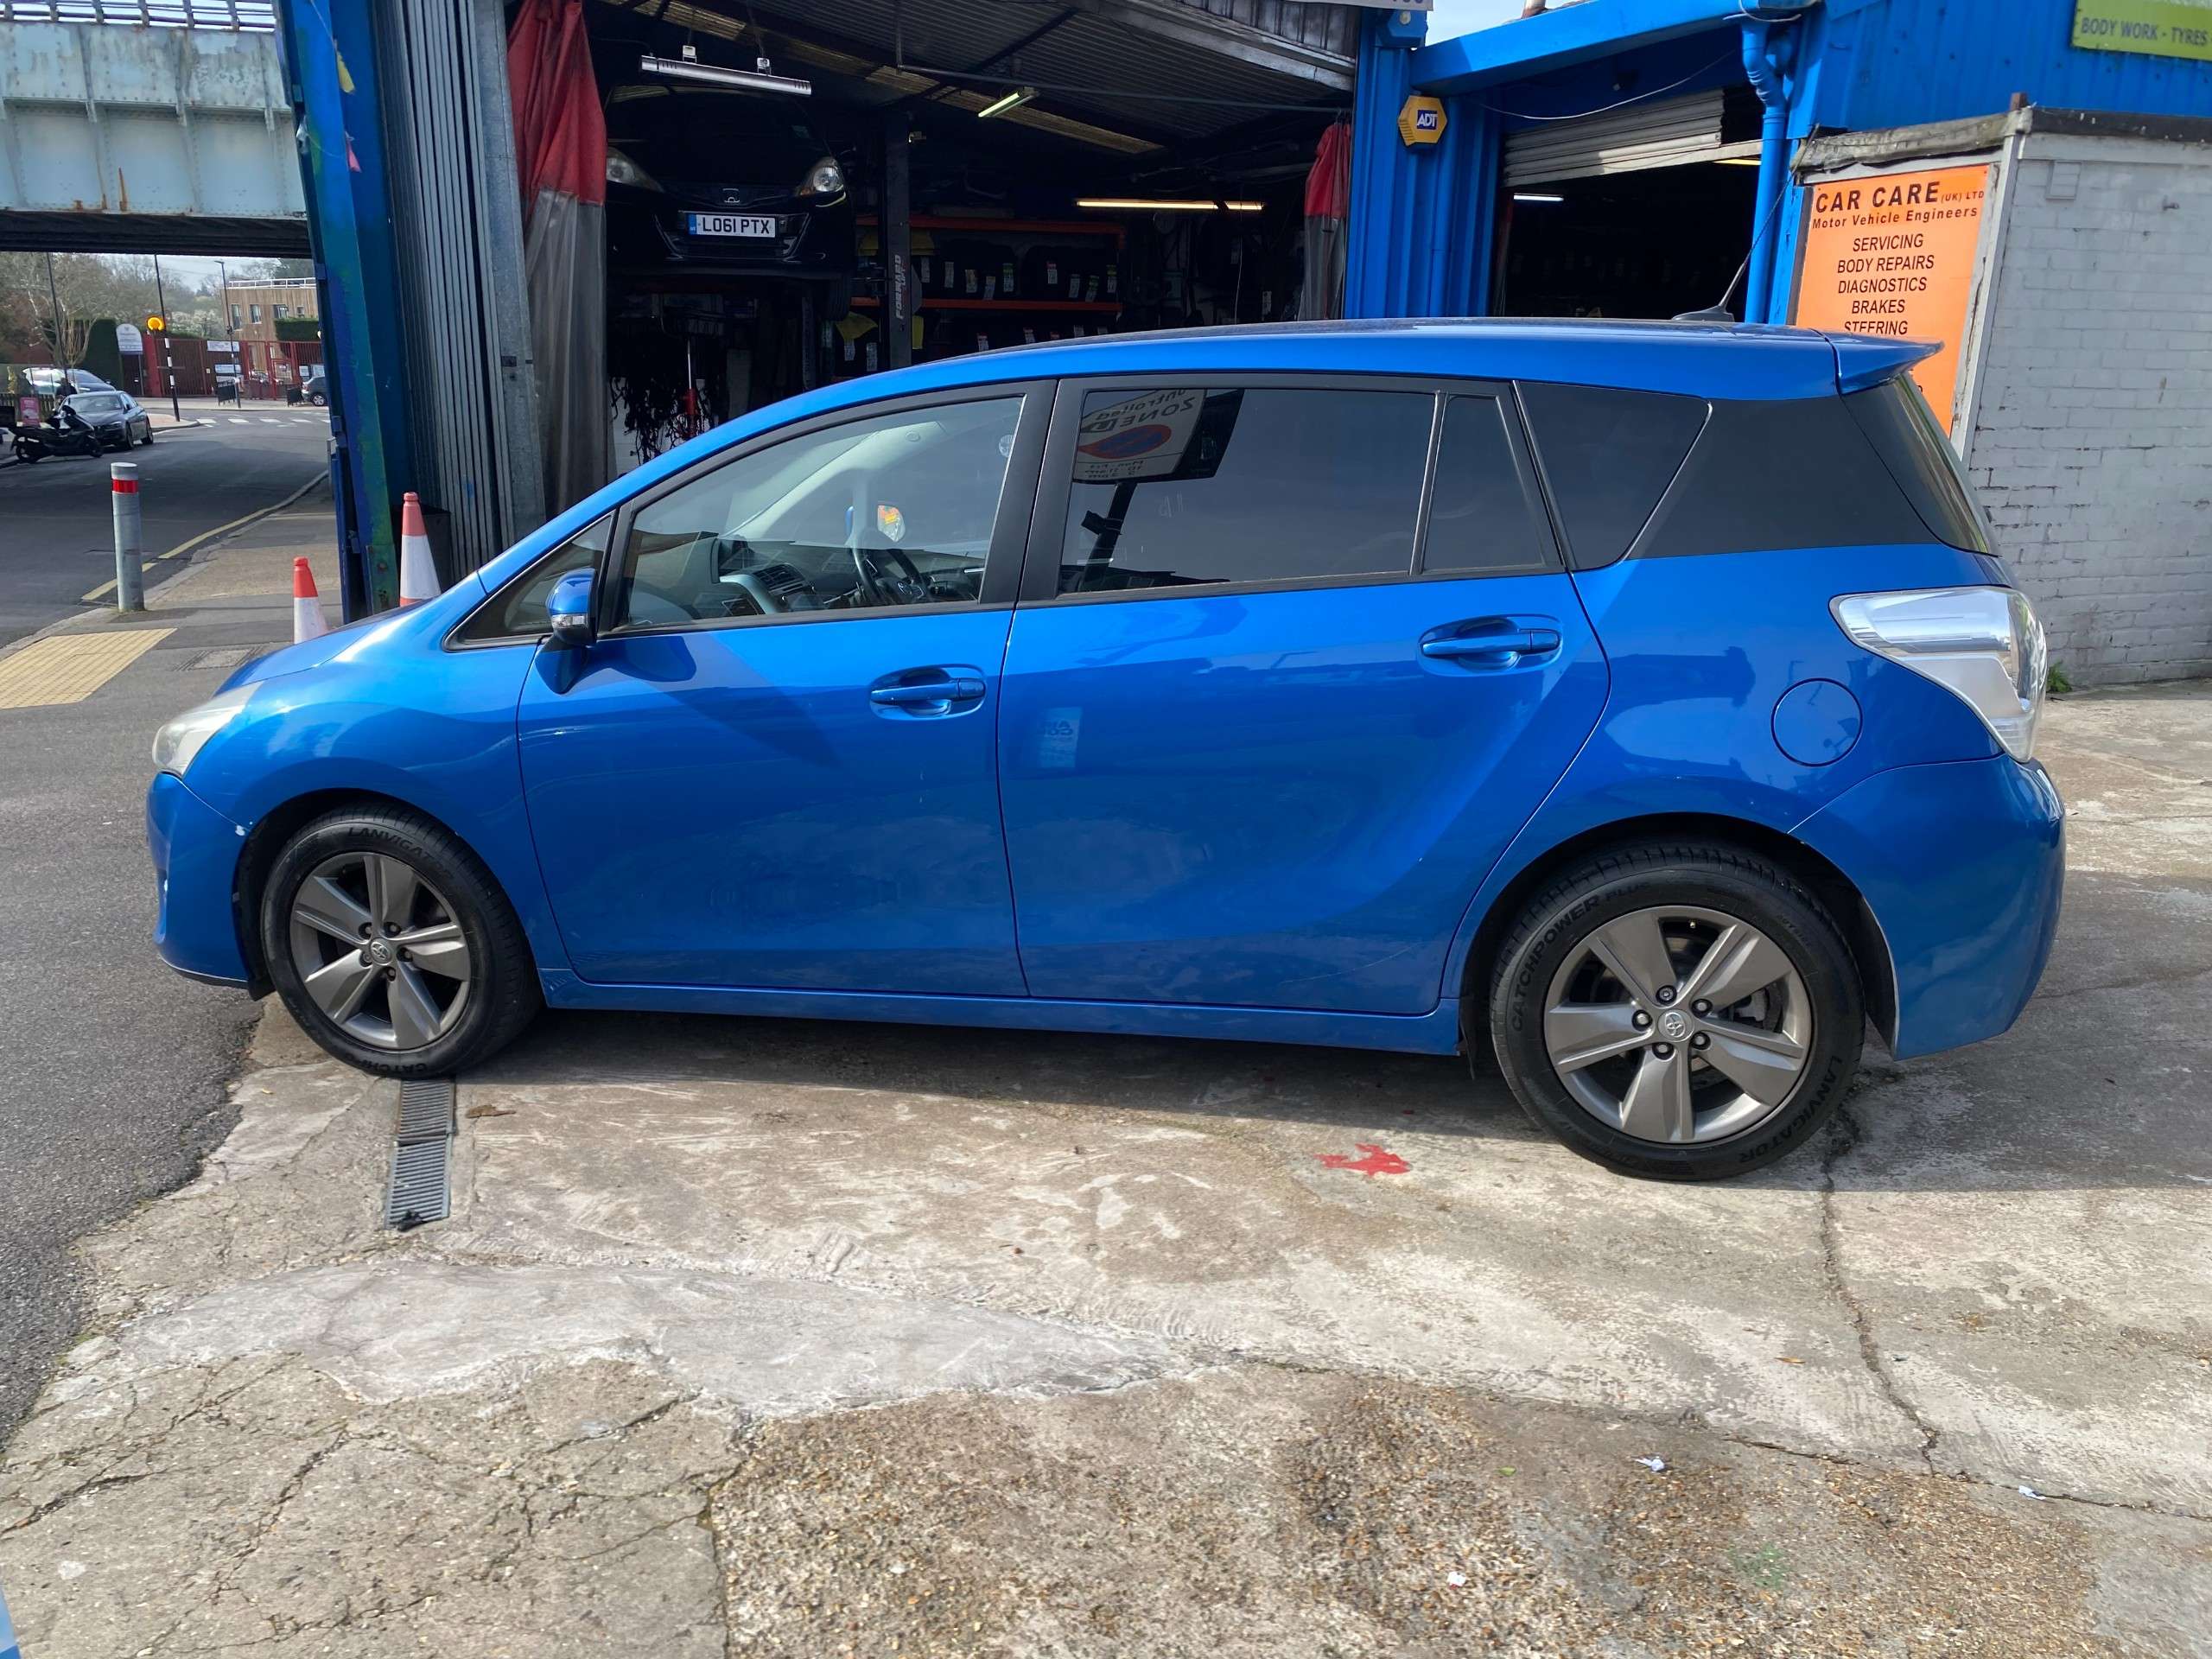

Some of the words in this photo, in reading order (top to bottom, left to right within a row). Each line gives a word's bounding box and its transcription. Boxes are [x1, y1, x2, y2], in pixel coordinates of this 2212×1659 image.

[2081, 17, 2117, 35] BODY
[2120, 20, 2158, 40] WORK
[2171, 27, 2209, 46] TYRES
[1417, 112, 1438, 127] ADT
[1815, 189, 1861, 213] CAR
[1872, 181, 1940, 207] CARE
[1941, 193, 1962, 204] (UK)
[1966, 190, 1984, 200] LTD
[702, 216, 736, 233] LO61
[741, 219, 770, 234] PTX
[1812, 217, 1847, 229] Motor
[1853, 212, 1899, 226] Vehicle
[1905, 207, 1978, 223] Engineers
[1853, 233, 1923, 252] SERVICING
[1837, 258, 1873, 274] BODY
[1876, 254, 1935, 272] REPAIRS
[894, 254, 904, 320] FORWARD
[1838, 276, 1928, 294] DIAGNOSTICS
[1852, 299, 1905, 314] BRAKES
[347, 827, 454, 880] LANVIGATOR
[1512, 894, 1599, 1032] CATCHPOWER
[1738, 1055, 1843, 1164] LANVIGATOR
